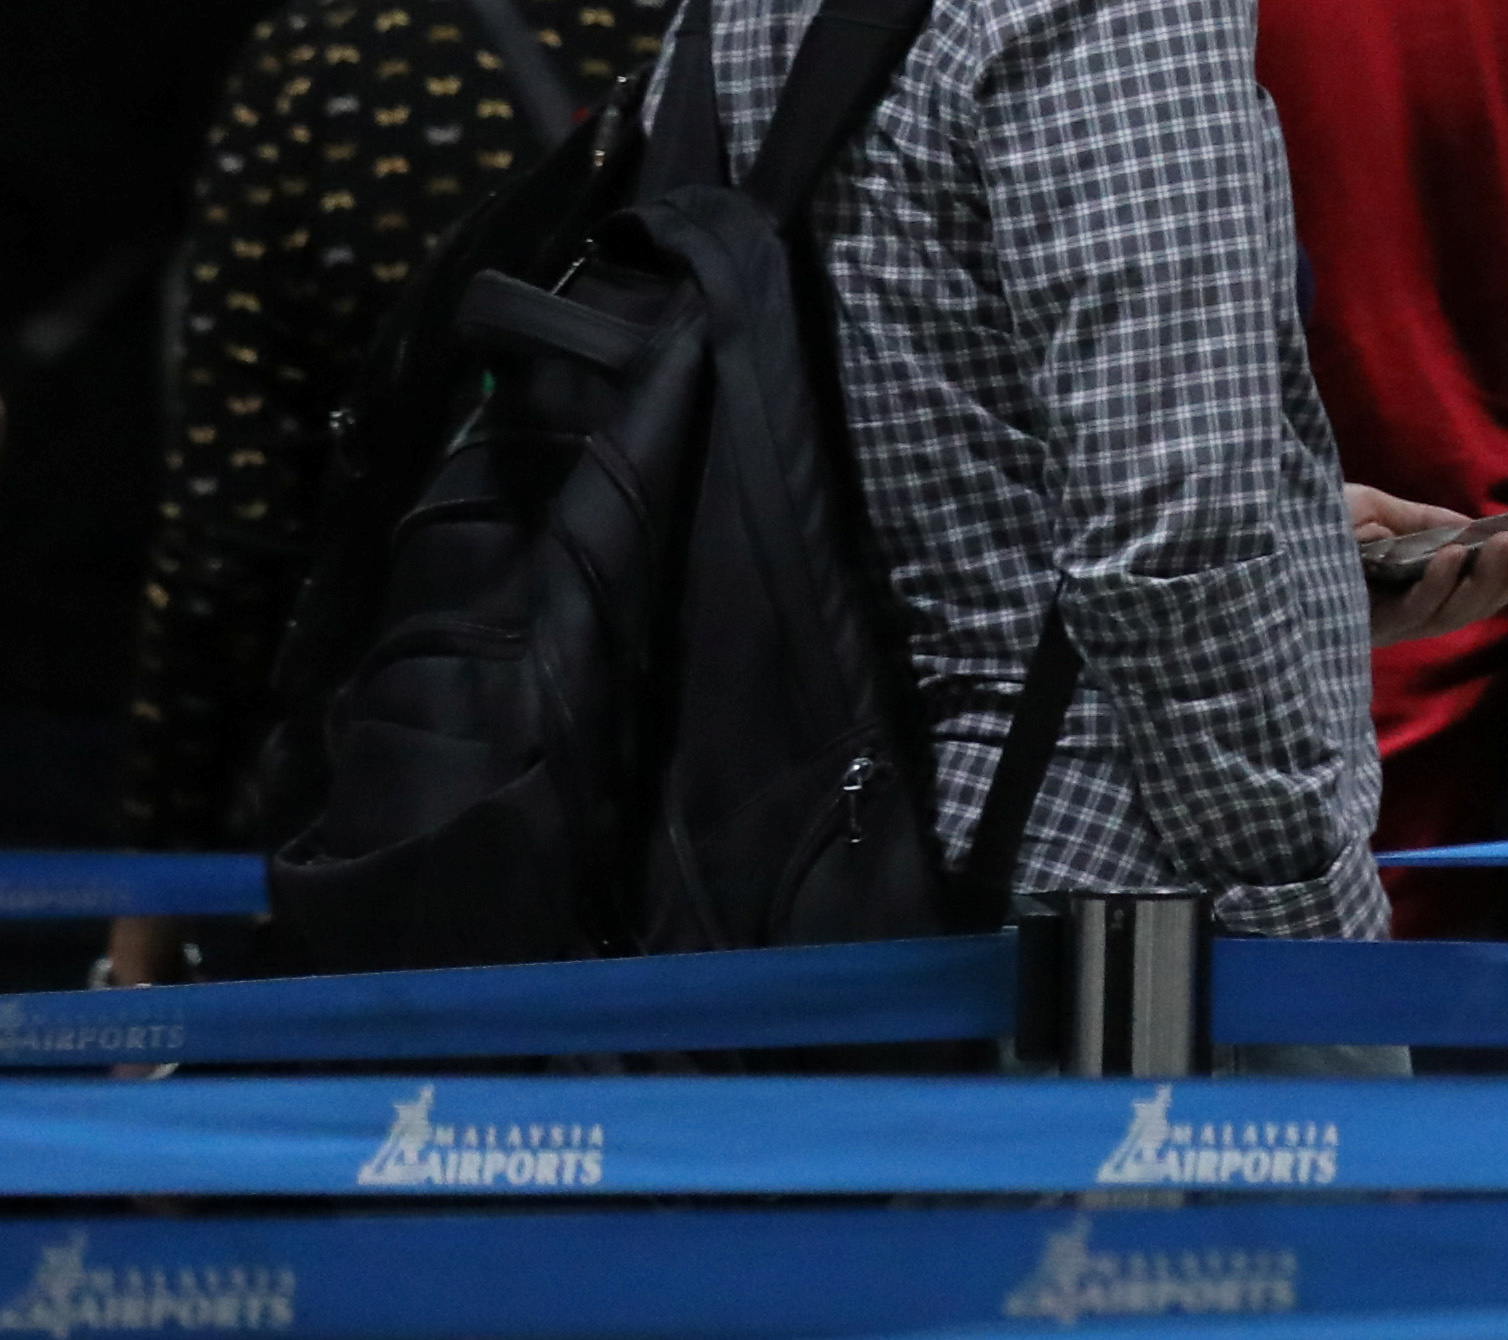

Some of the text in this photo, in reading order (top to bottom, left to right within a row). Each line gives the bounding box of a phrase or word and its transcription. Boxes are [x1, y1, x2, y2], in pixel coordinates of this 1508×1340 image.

[22, 1024, 185, 1052] AIRPORTS
[435, 1124, 604, 1148] MALAYSIA
[1171, 1123, 1340, 1147] MALAYSIA
[424, 1150, 604, 1185] AIRPORTS
[1164, 1149, 1339, 1184] AIRPORTS
[74, 1296, 295, 1330] AIRPORTS
